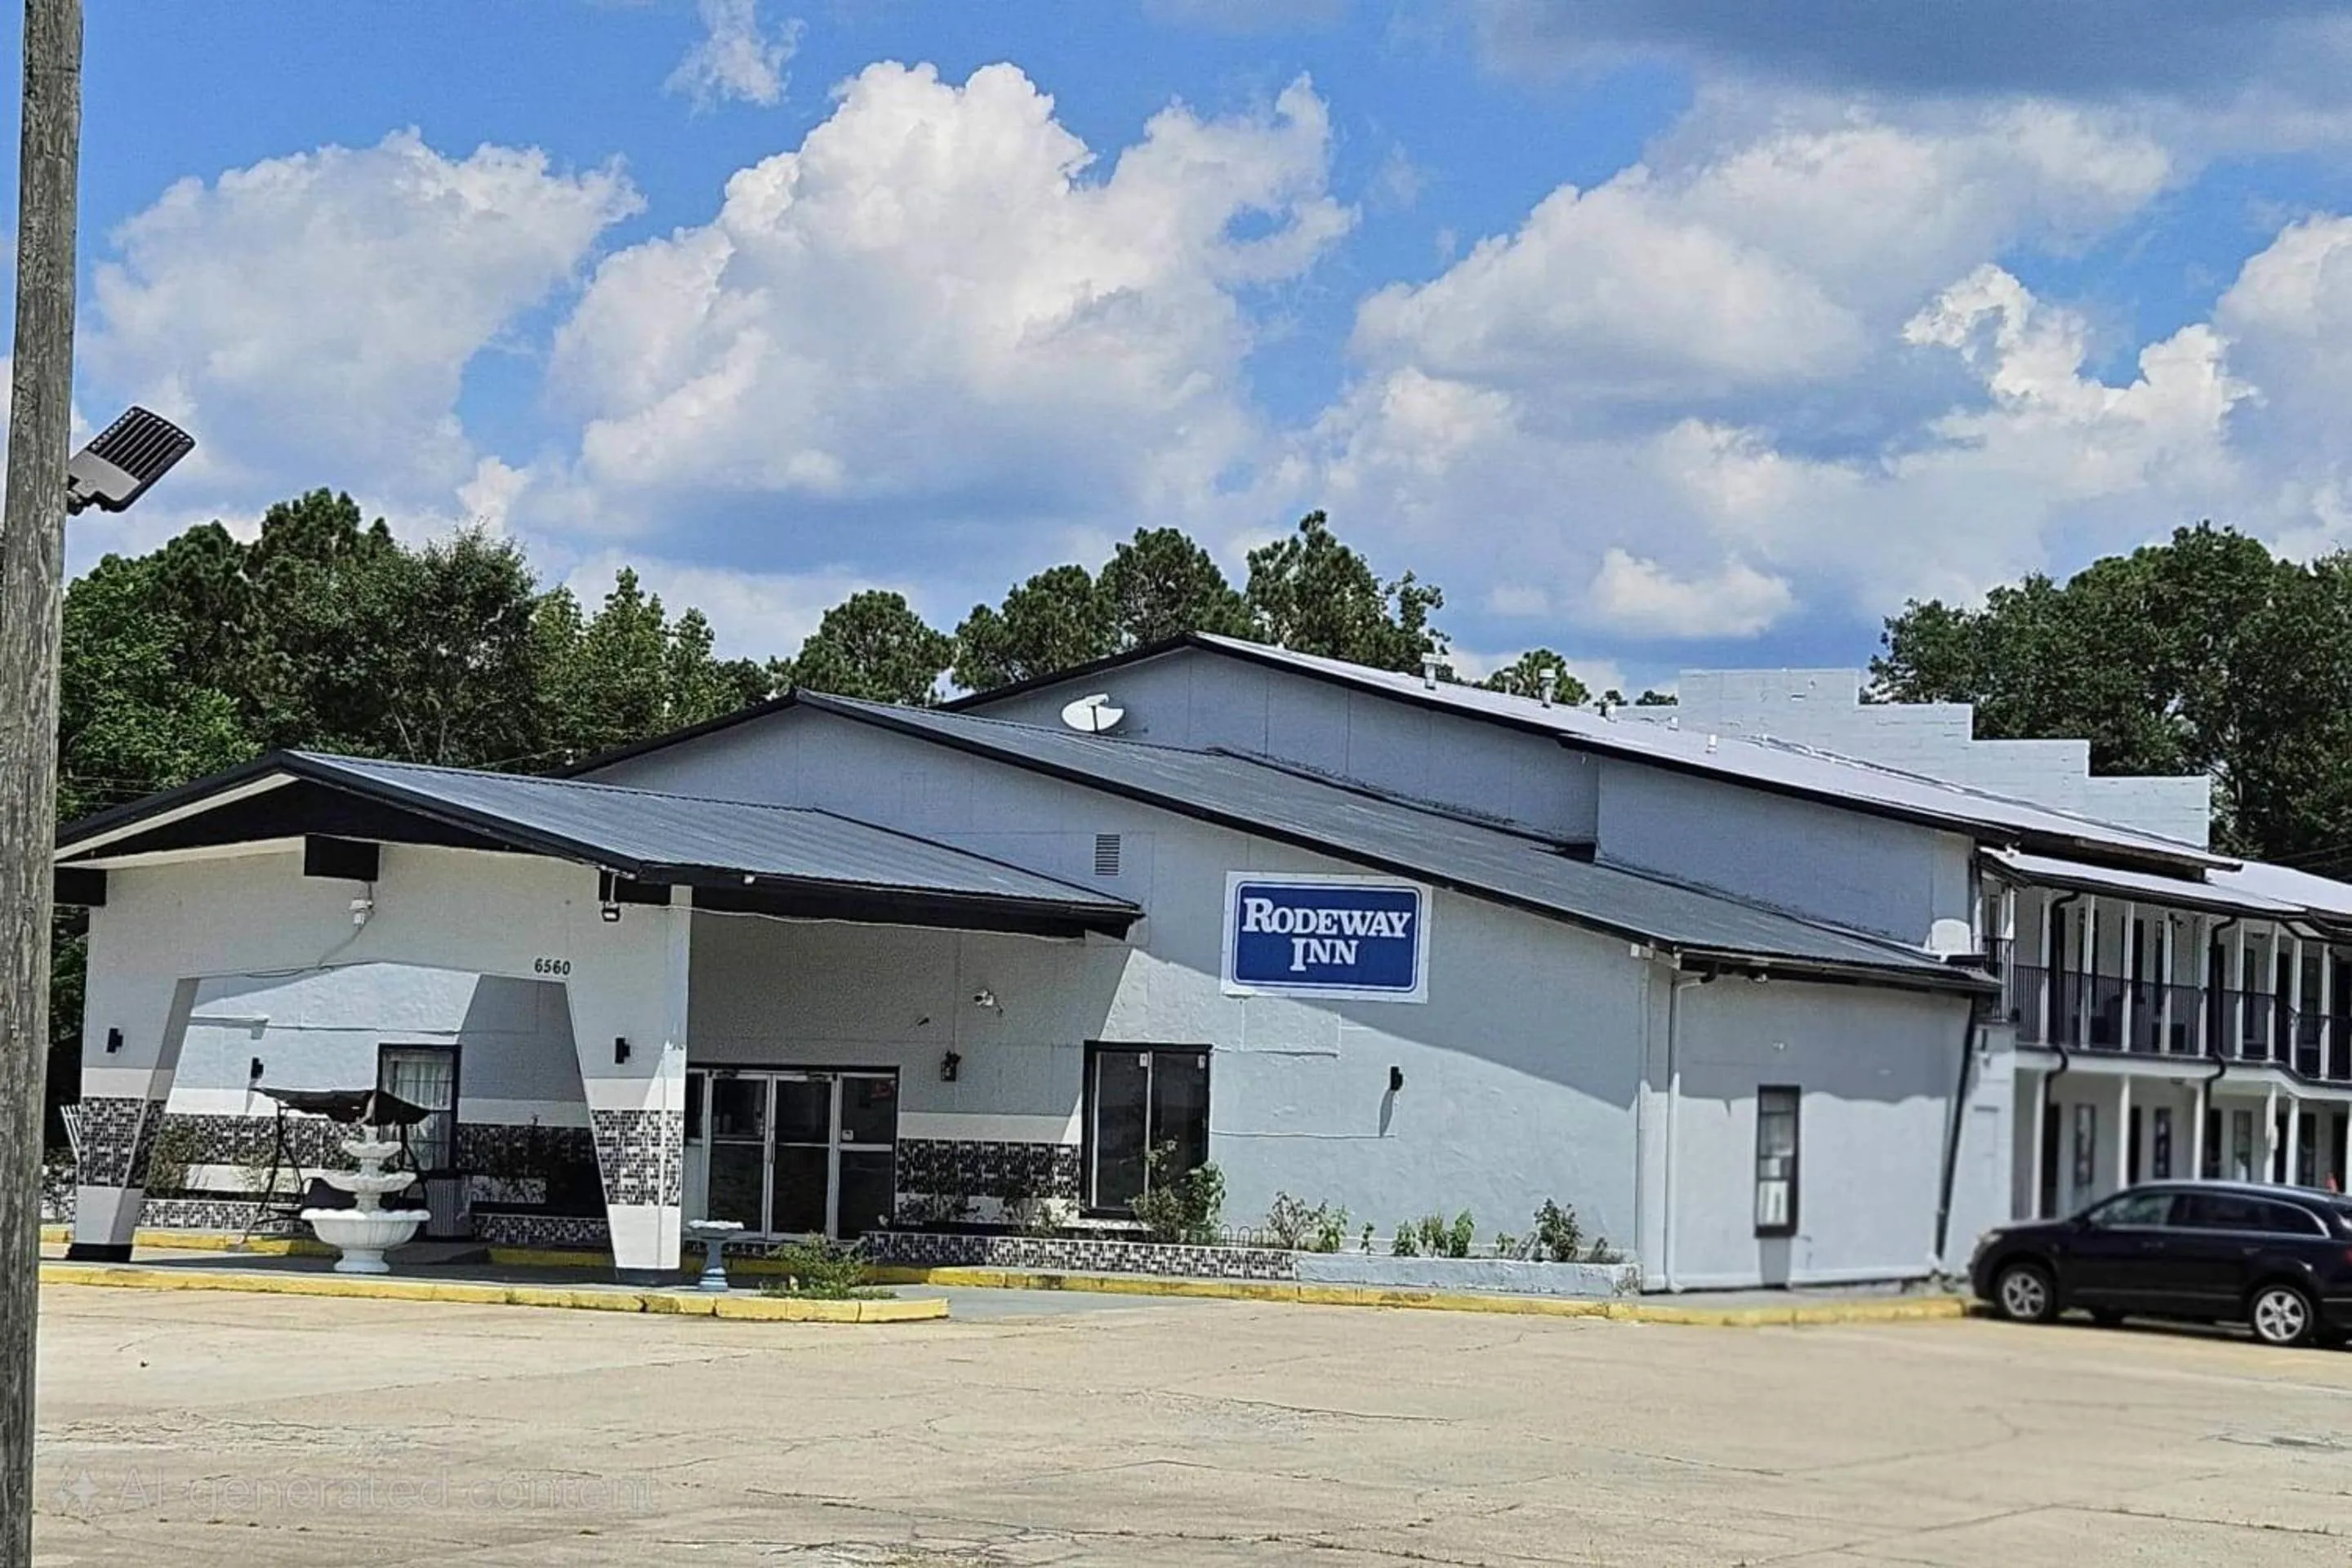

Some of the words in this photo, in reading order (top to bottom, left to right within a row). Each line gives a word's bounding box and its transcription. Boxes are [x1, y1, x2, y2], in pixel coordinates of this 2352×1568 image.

[1241, 898, 1411, 938] RODEWAY
[534, 957, 572, 975] 6560
[1290, 938, 1359, 971] INN
